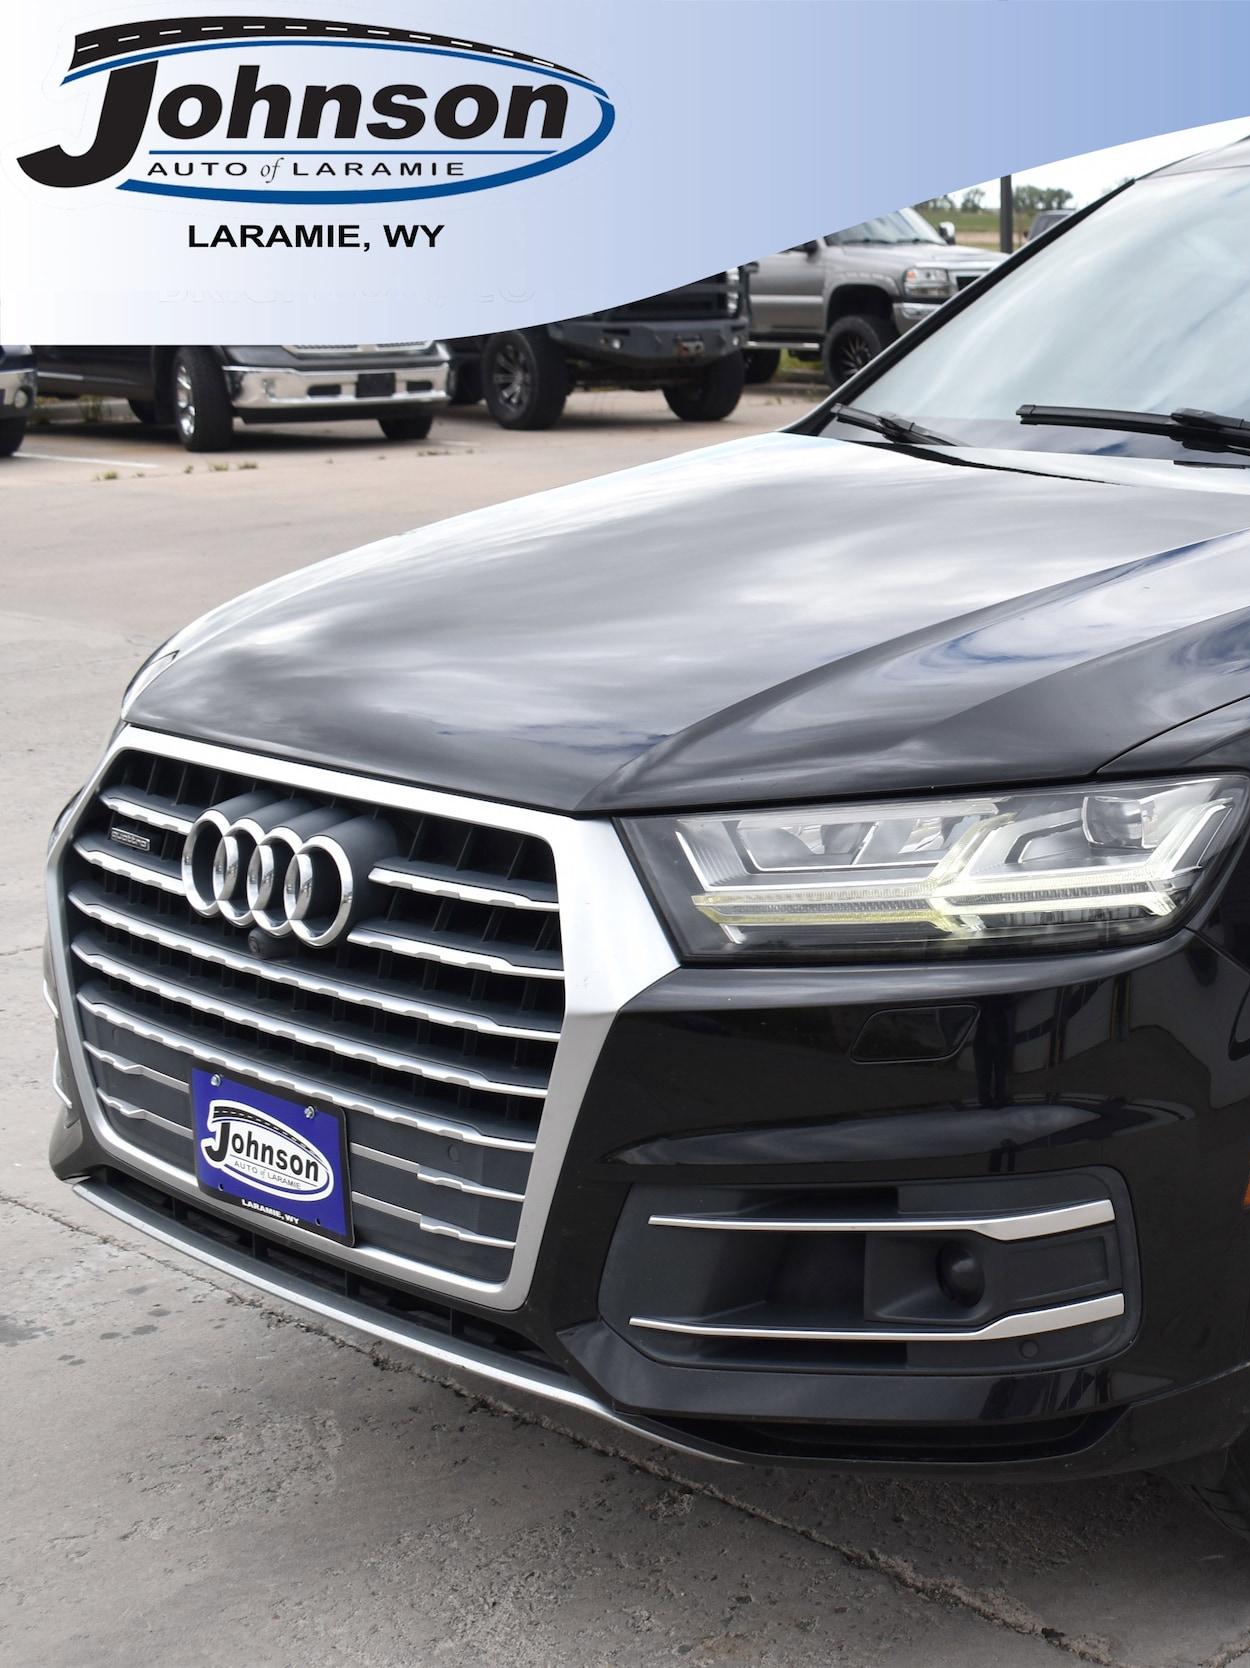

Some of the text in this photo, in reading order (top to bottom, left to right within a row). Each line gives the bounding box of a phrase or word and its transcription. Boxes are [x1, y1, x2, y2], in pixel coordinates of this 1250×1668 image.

[204, 1121, 319, 1182] Johnson
[234, 1160, 258, 1174] AUTO
[267, 1171, 301, 1190] LARAMIE
[285, 1213, 300, 1225] WY
